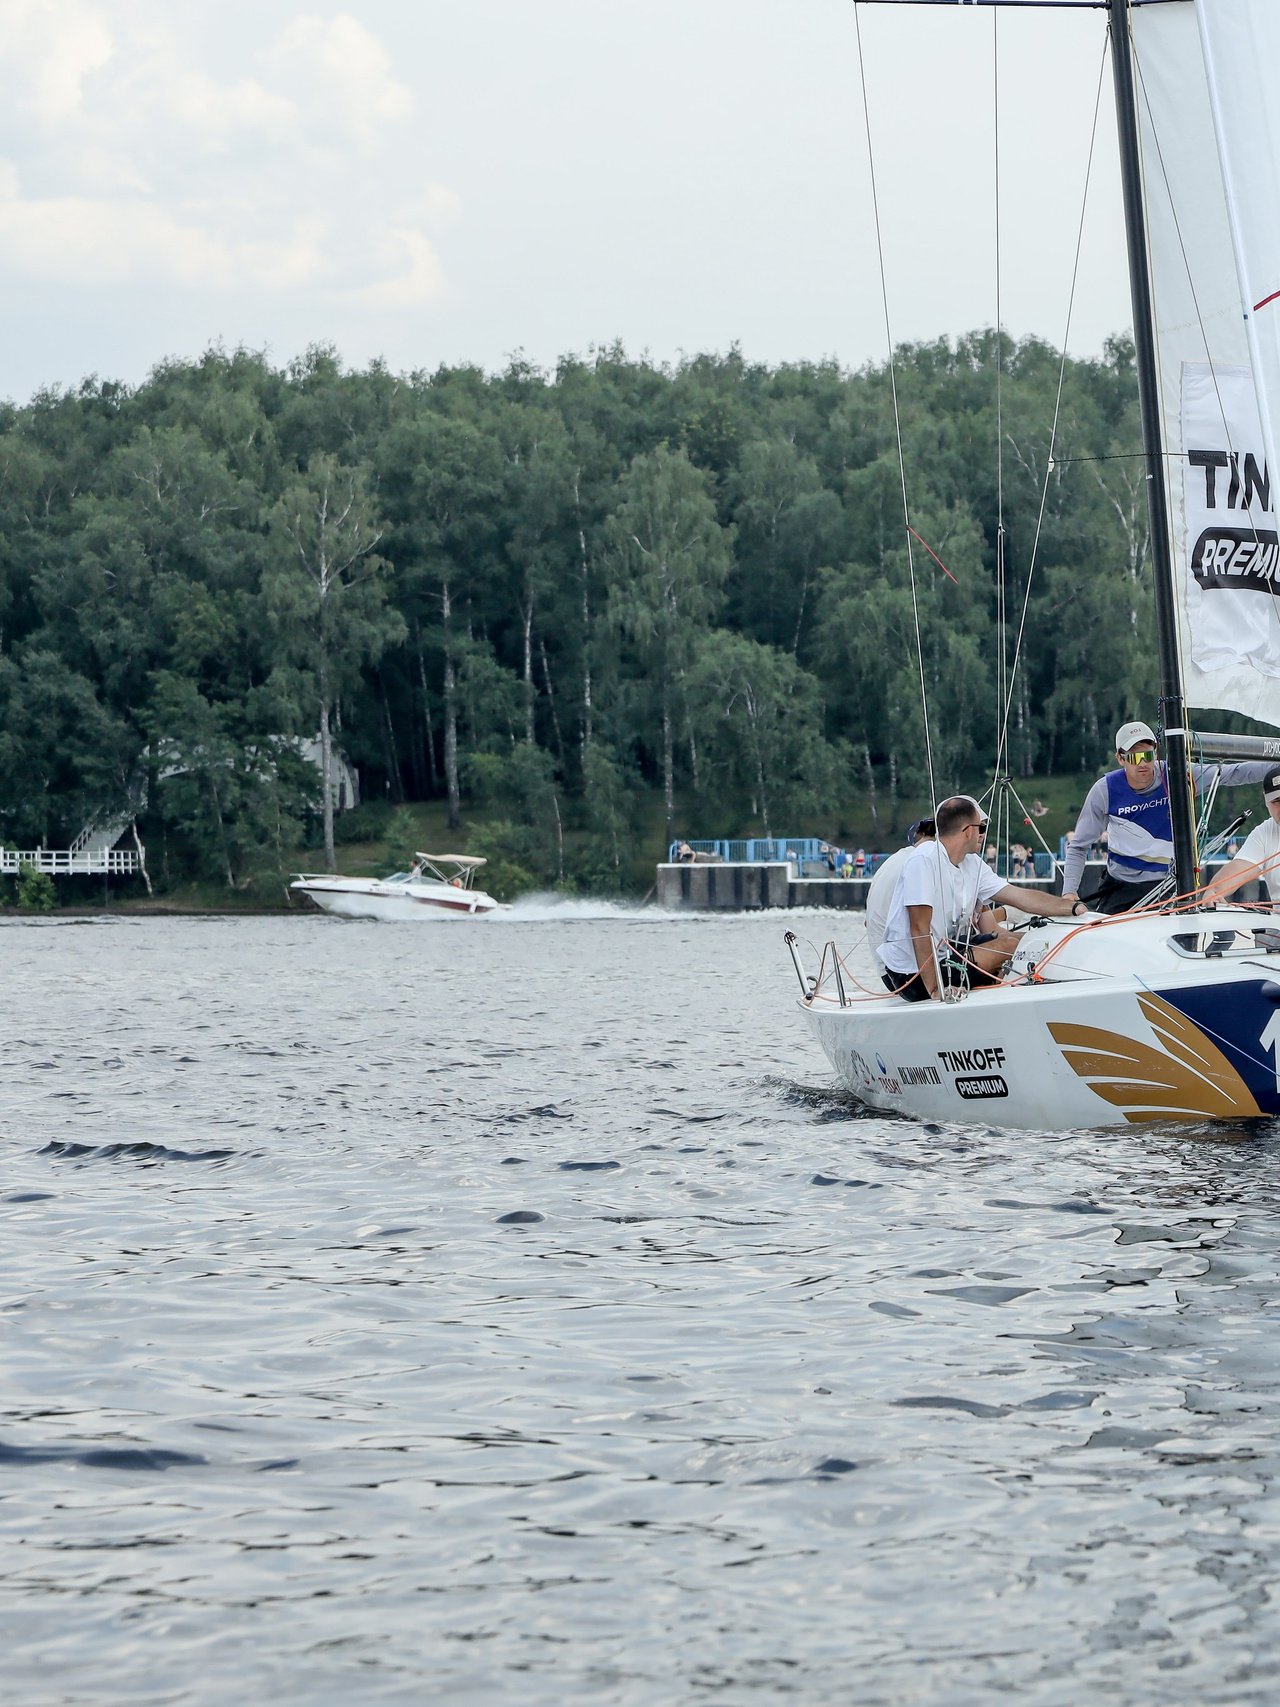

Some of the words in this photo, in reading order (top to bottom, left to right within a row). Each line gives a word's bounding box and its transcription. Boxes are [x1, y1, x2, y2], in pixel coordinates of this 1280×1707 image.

[1188, 449, 1275, 513] TIN
[937, 1047, 1006, 1072] TINKOFF
[957, 1079, 1006, 1096] PREMIUM
